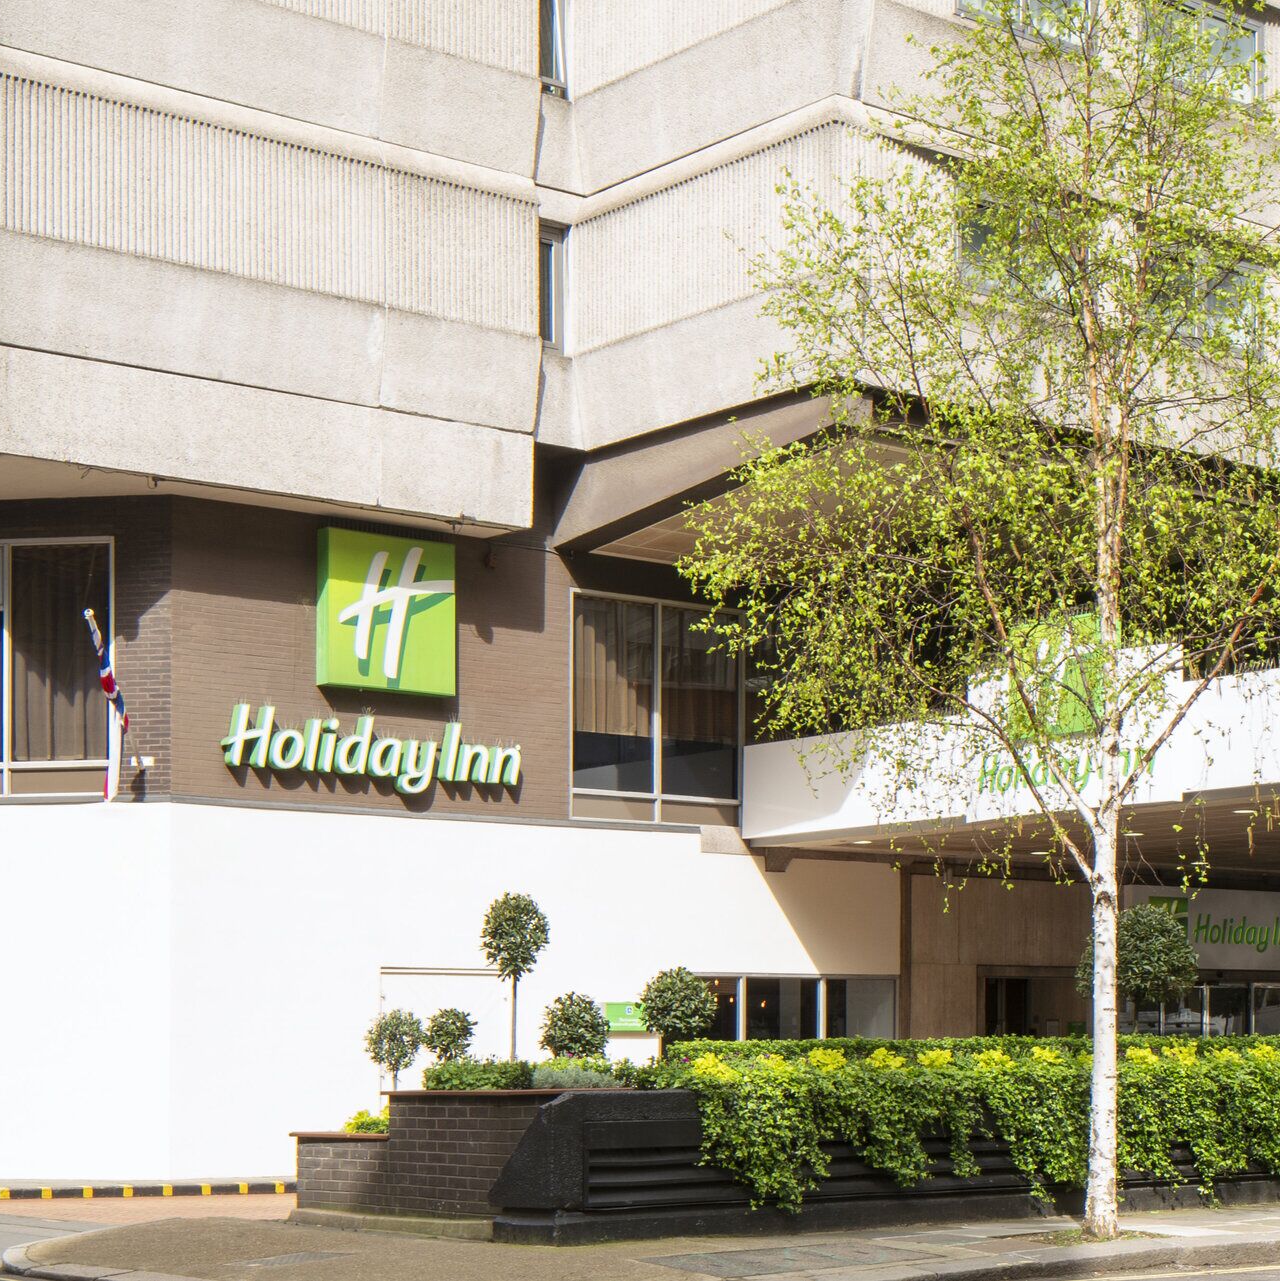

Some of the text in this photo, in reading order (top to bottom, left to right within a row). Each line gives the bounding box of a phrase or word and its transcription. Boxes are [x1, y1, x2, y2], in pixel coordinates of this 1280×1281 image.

[220, 703, 522, 795] Holiday Inn
[1193, 913, 1270, 953] Holiday
